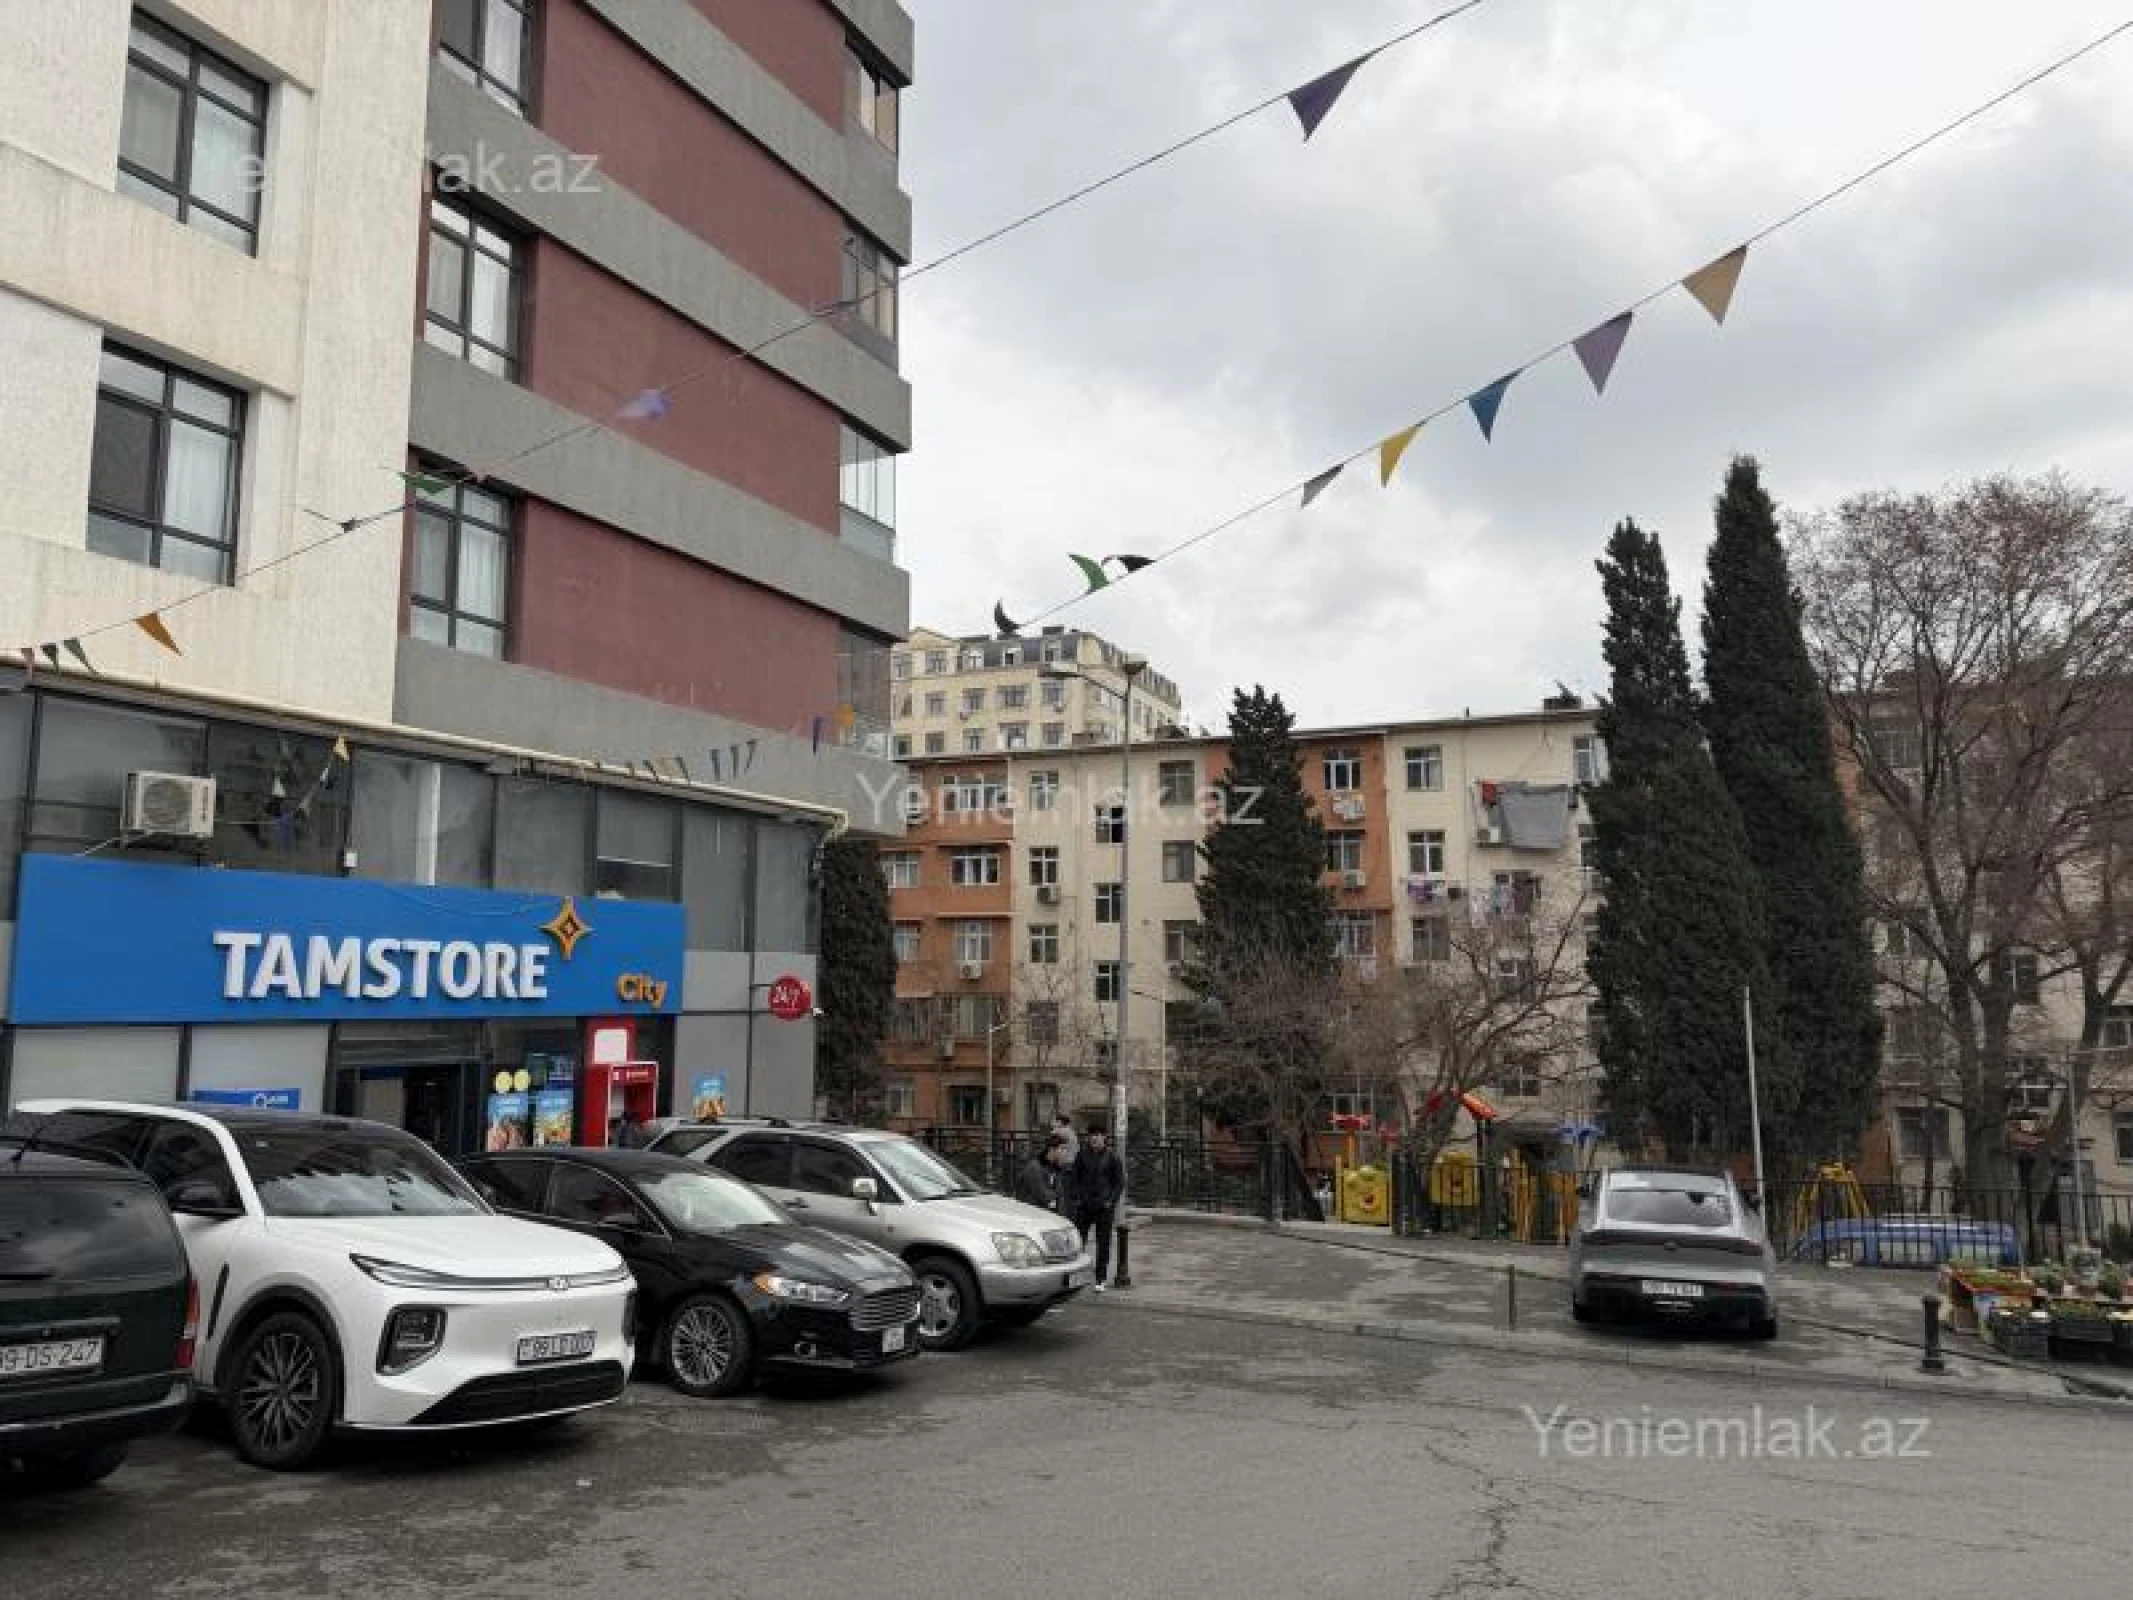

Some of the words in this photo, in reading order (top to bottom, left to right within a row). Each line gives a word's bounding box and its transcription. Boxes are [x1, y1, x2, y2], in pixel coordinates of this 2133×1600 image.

[213, 930, 550, 999] TAMSTORE
[616, 972, 668, 1008] City
[771, 985, 801, 1006] 24/7
